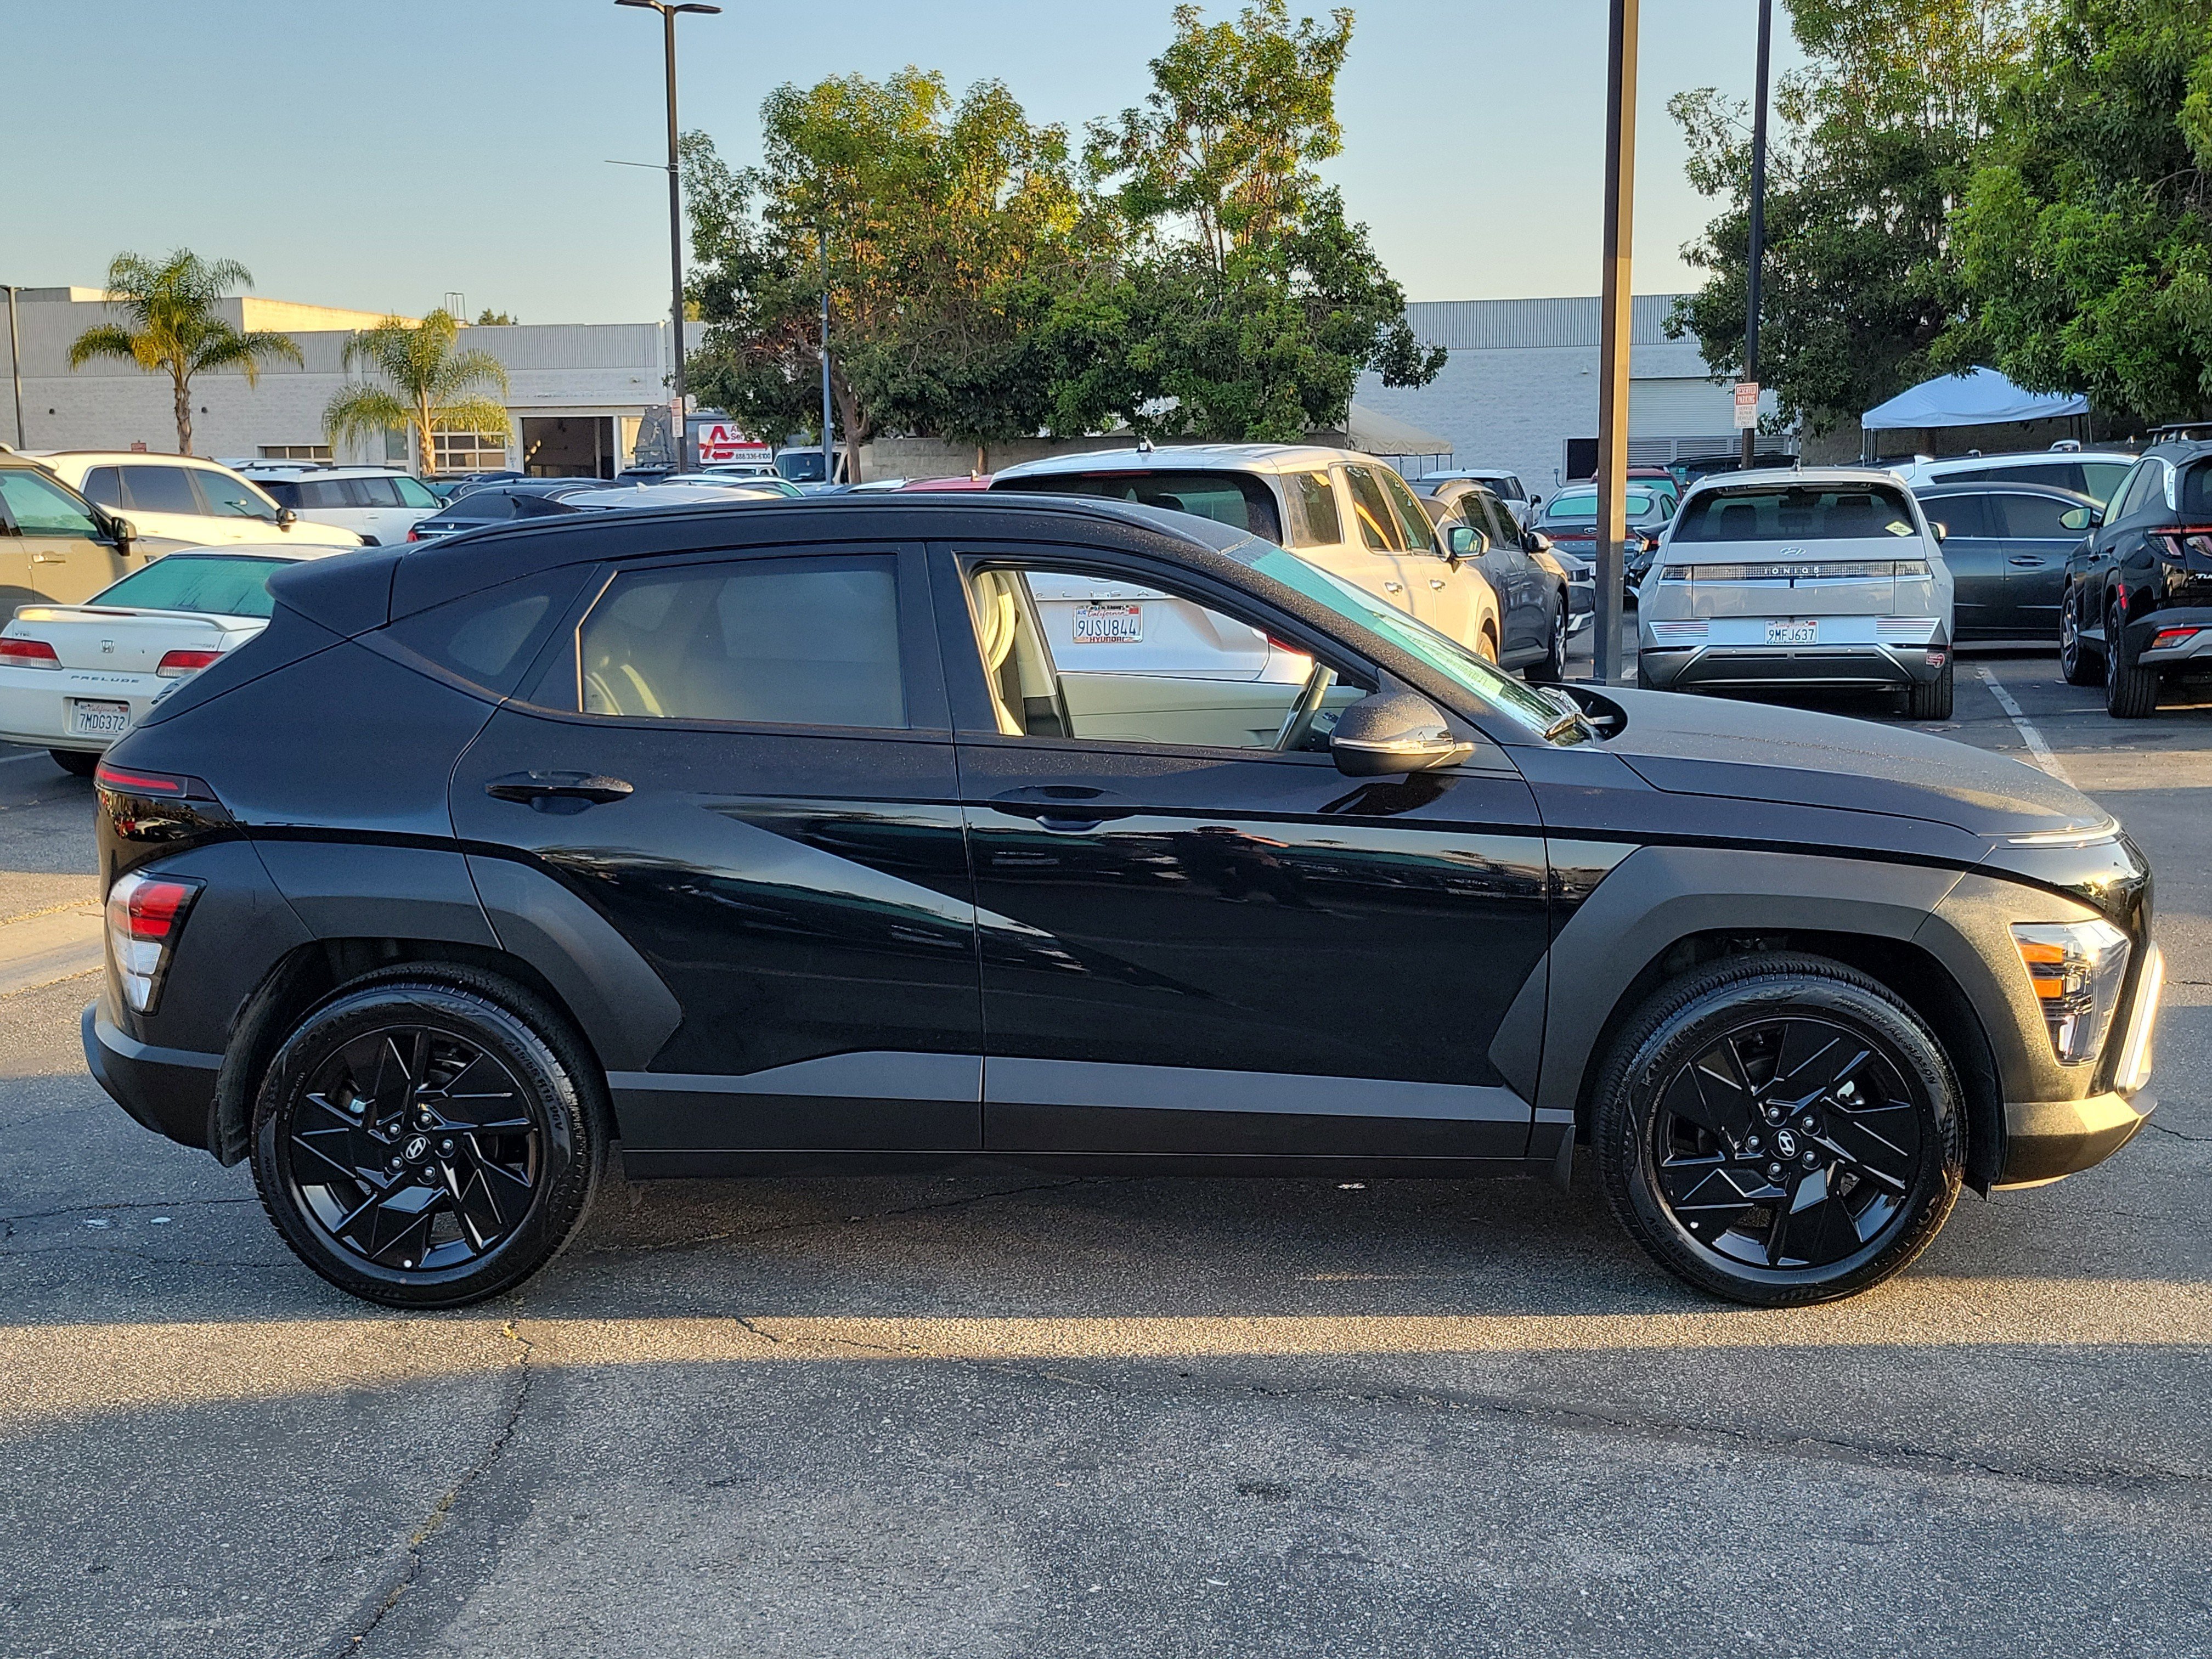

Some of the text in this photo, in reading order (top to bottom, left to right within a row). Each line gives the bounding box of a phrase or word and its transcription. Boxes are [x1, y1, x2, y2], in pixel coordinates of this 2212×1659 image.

[1077, 619, 1136, 636] 9USU844
[1769, 629, 1814, 641] 9MFJ637
[71, 675, 140, 684] PRELUDE
[80, 713, 126, 731] 7MDG372
